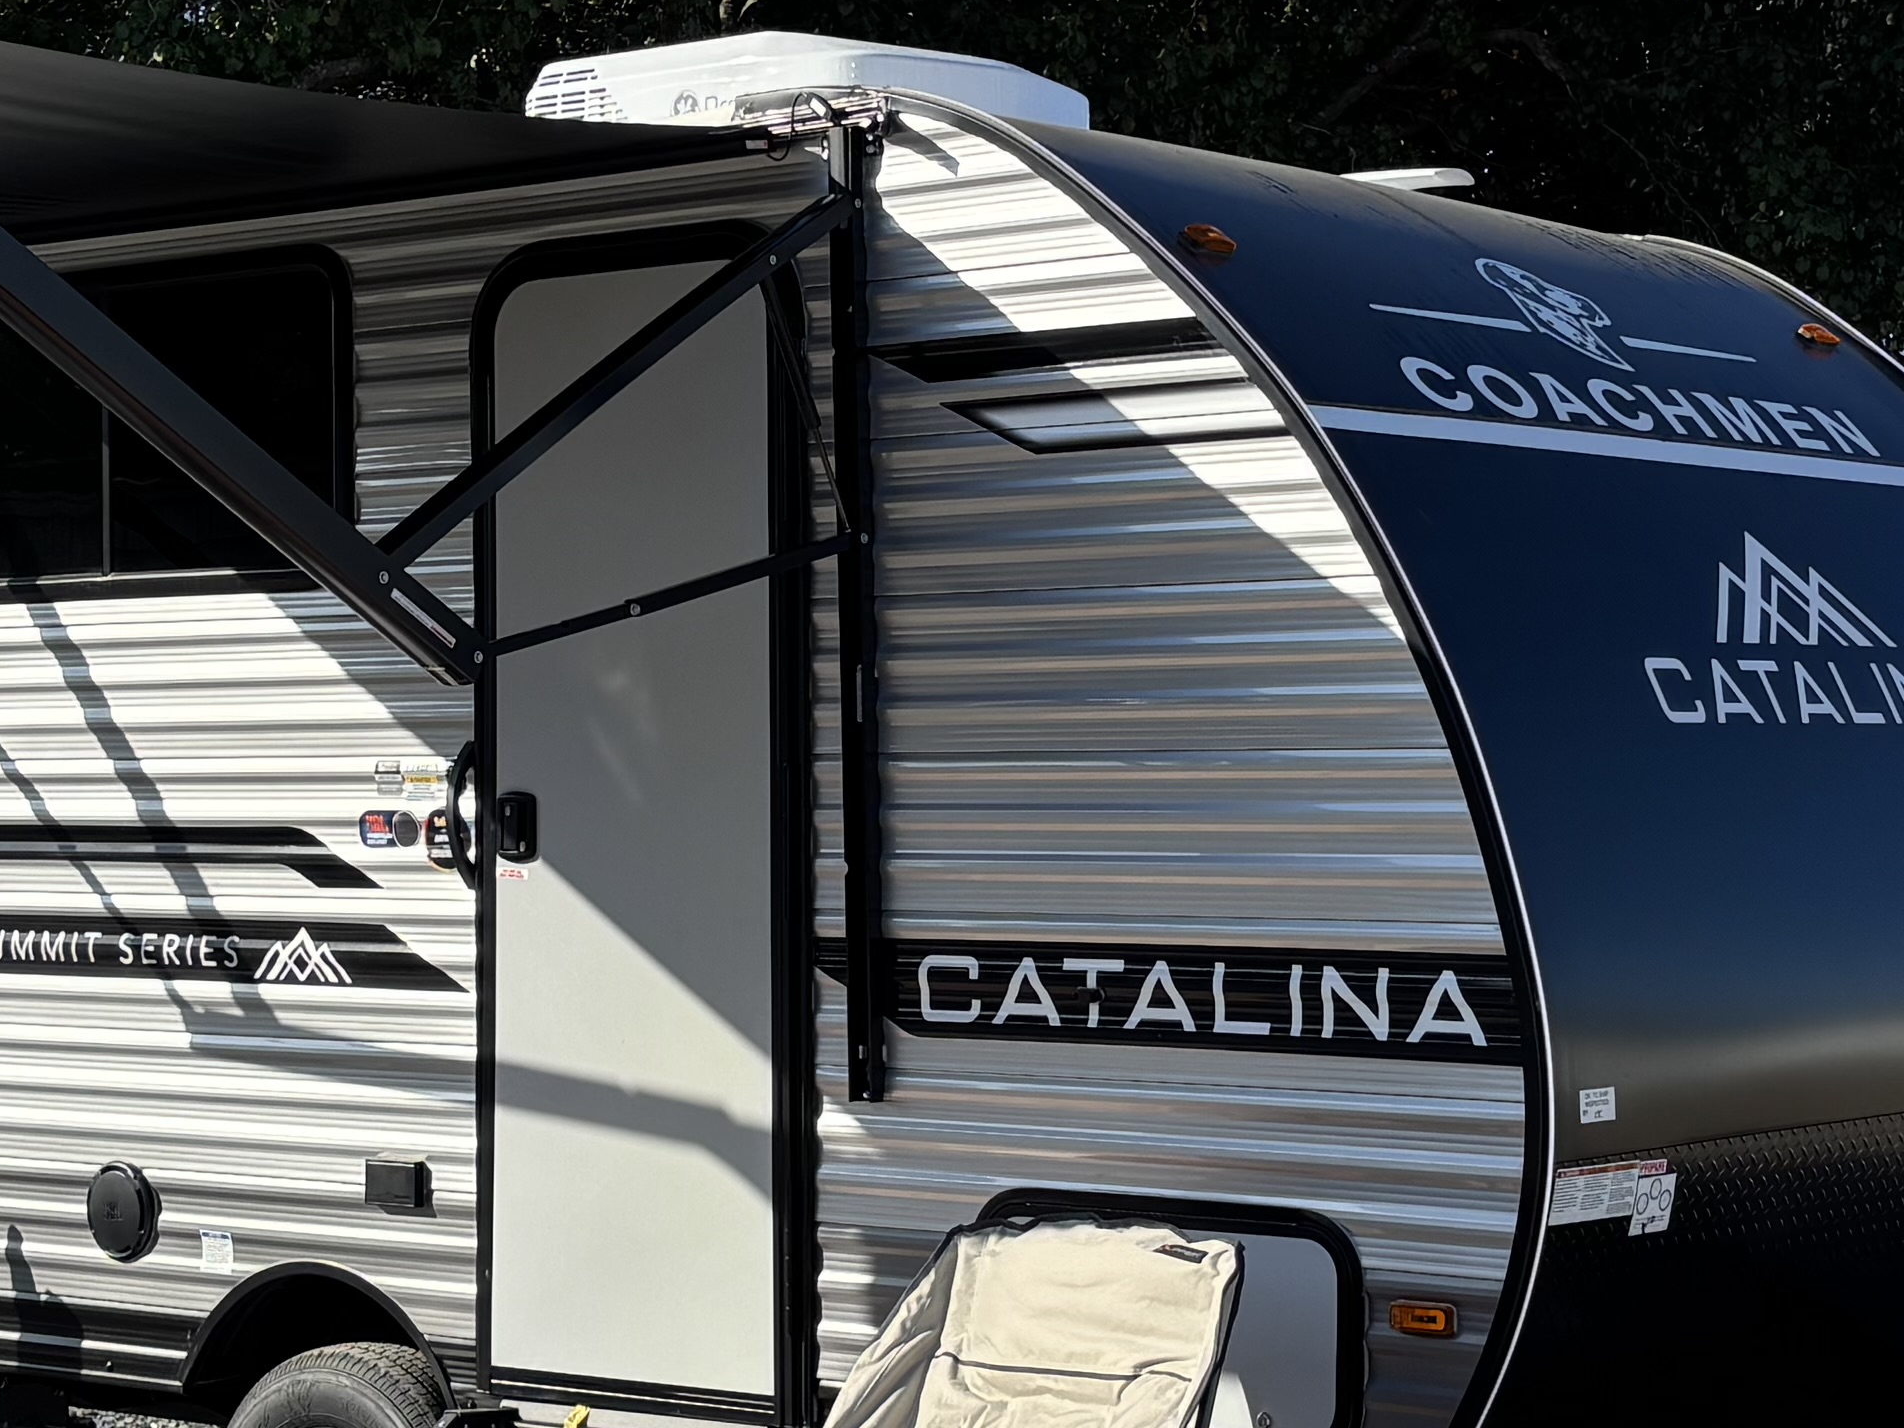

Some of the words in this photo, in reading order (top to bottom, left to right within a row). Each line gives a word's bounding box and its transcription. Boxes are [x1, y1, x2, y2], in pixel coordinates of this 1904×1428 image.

[1399, 355, 1881, 457] COACHMEN
[117, 931, 241, 969] SERIES
[917, 954, 1489, 1047] CATALINA
